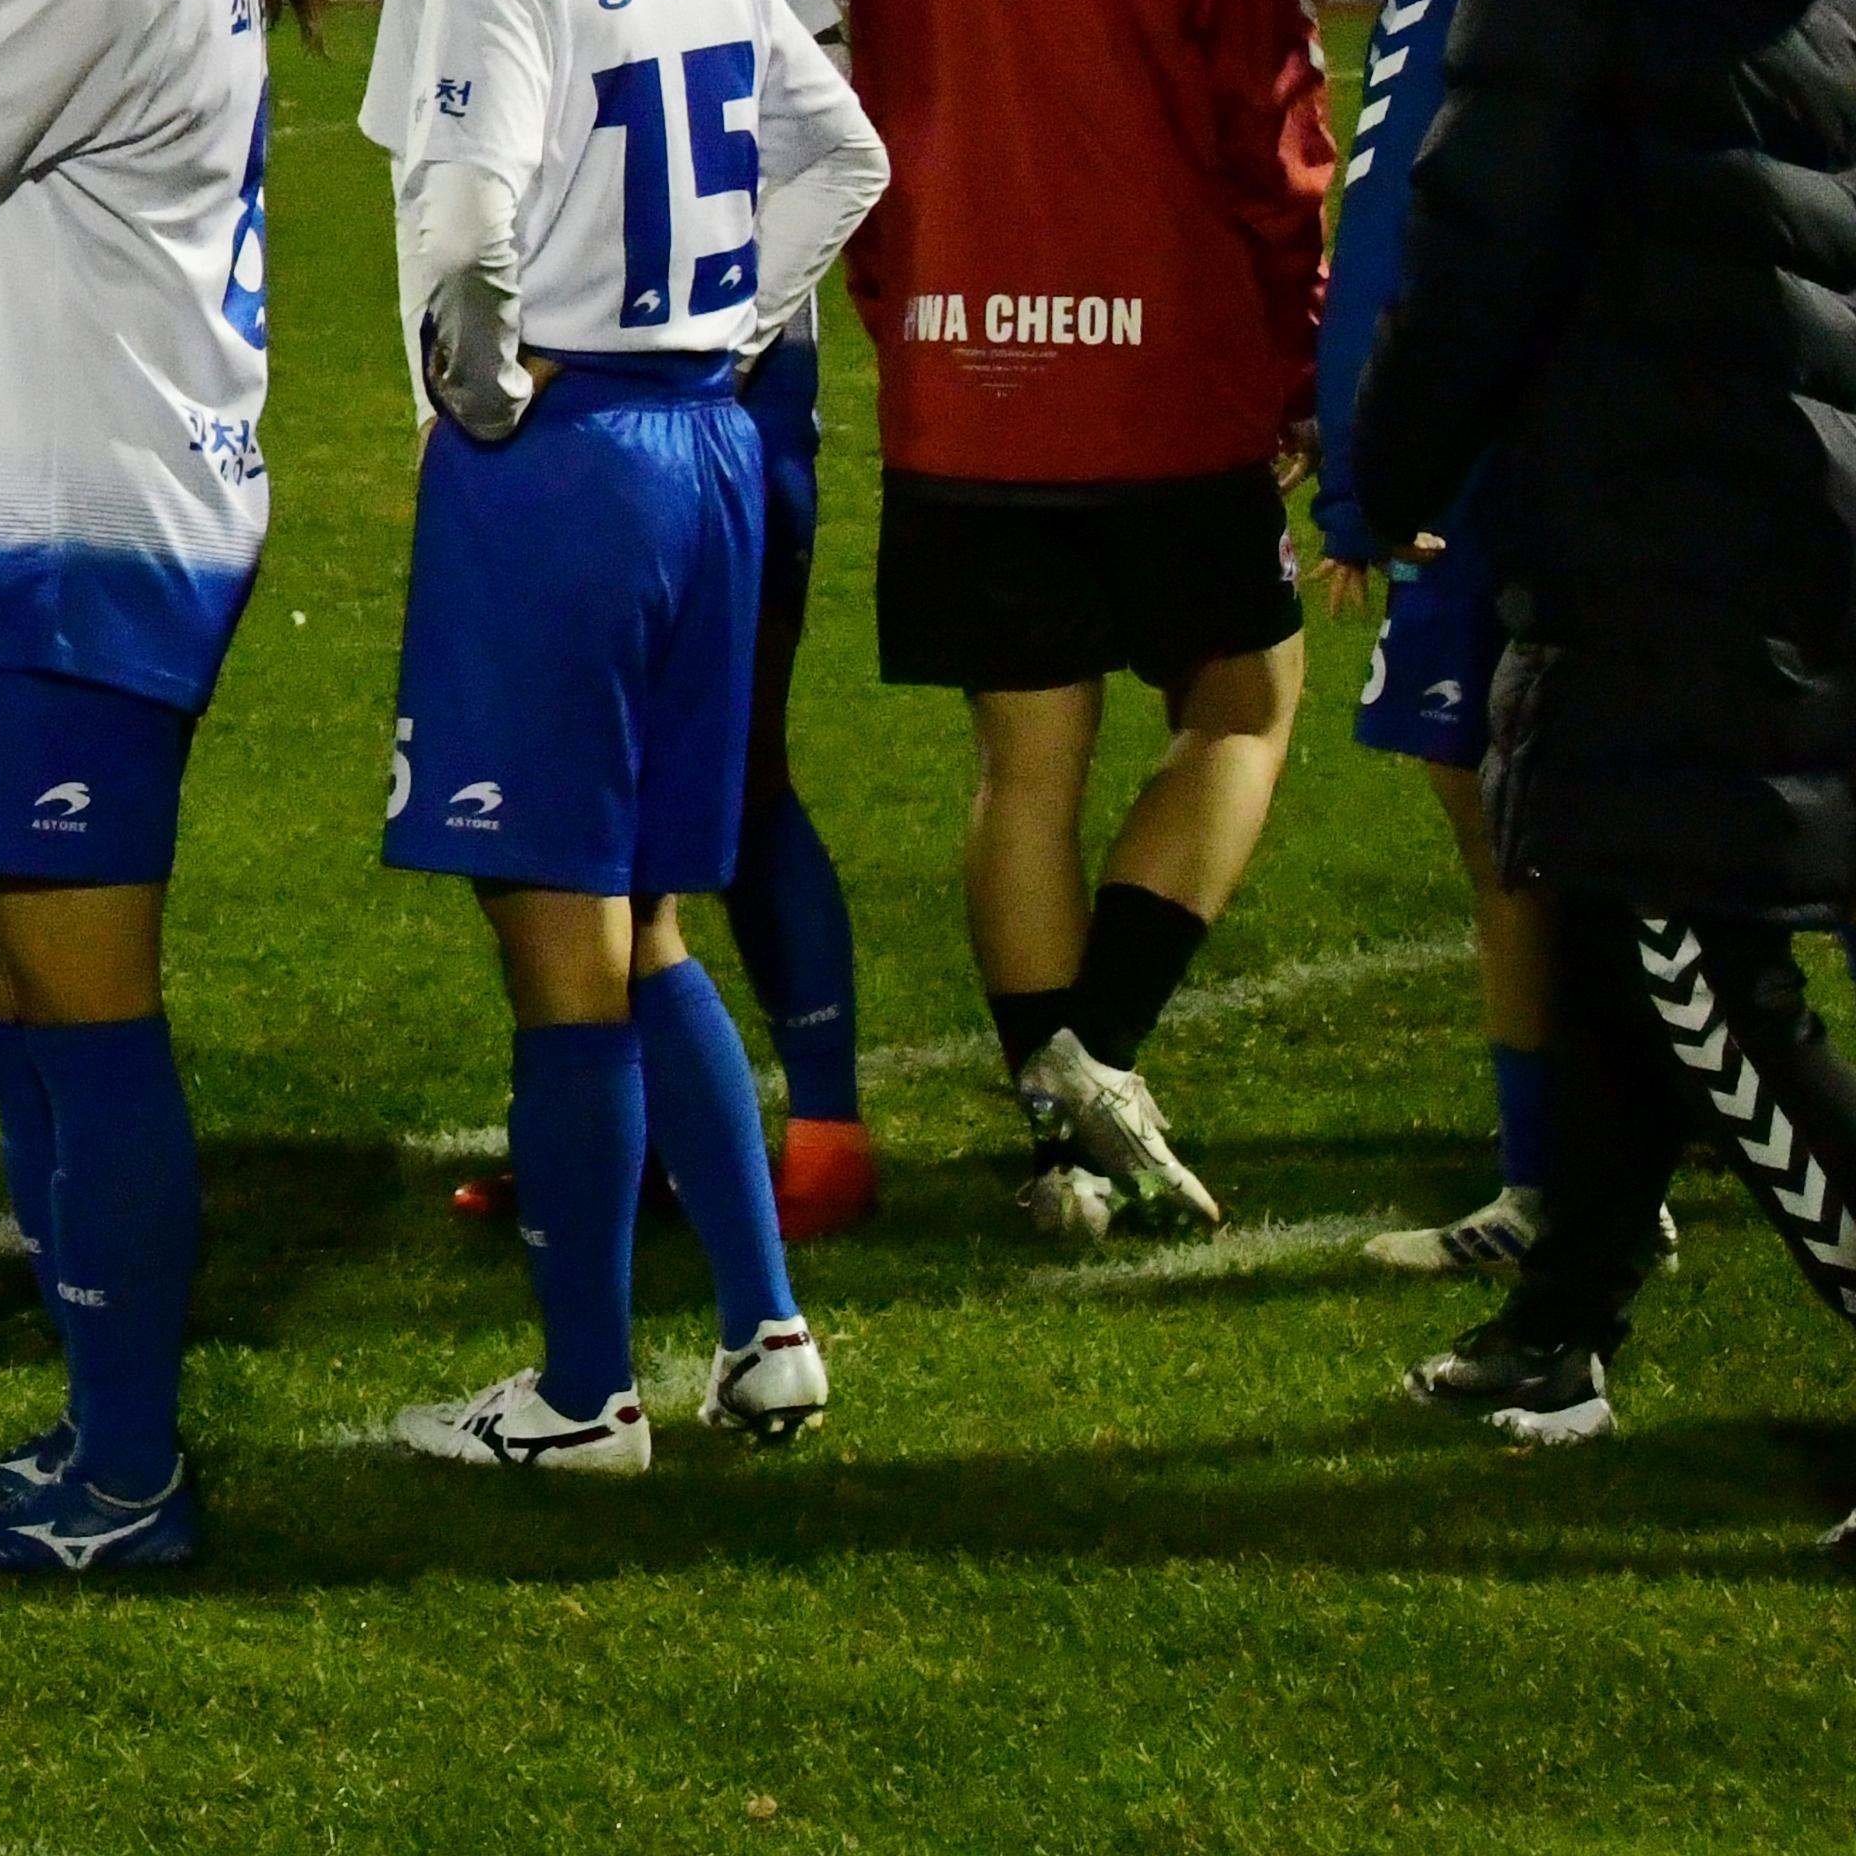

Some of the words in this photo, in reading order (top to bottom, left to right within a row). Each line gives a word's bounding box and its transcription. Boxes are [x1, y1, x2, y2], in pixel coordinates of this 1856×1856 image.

[592, 41, 759, 328] 15
[985, 294, 1143, 346] CHEON
[31, 819, 88, 833] ASTORE
